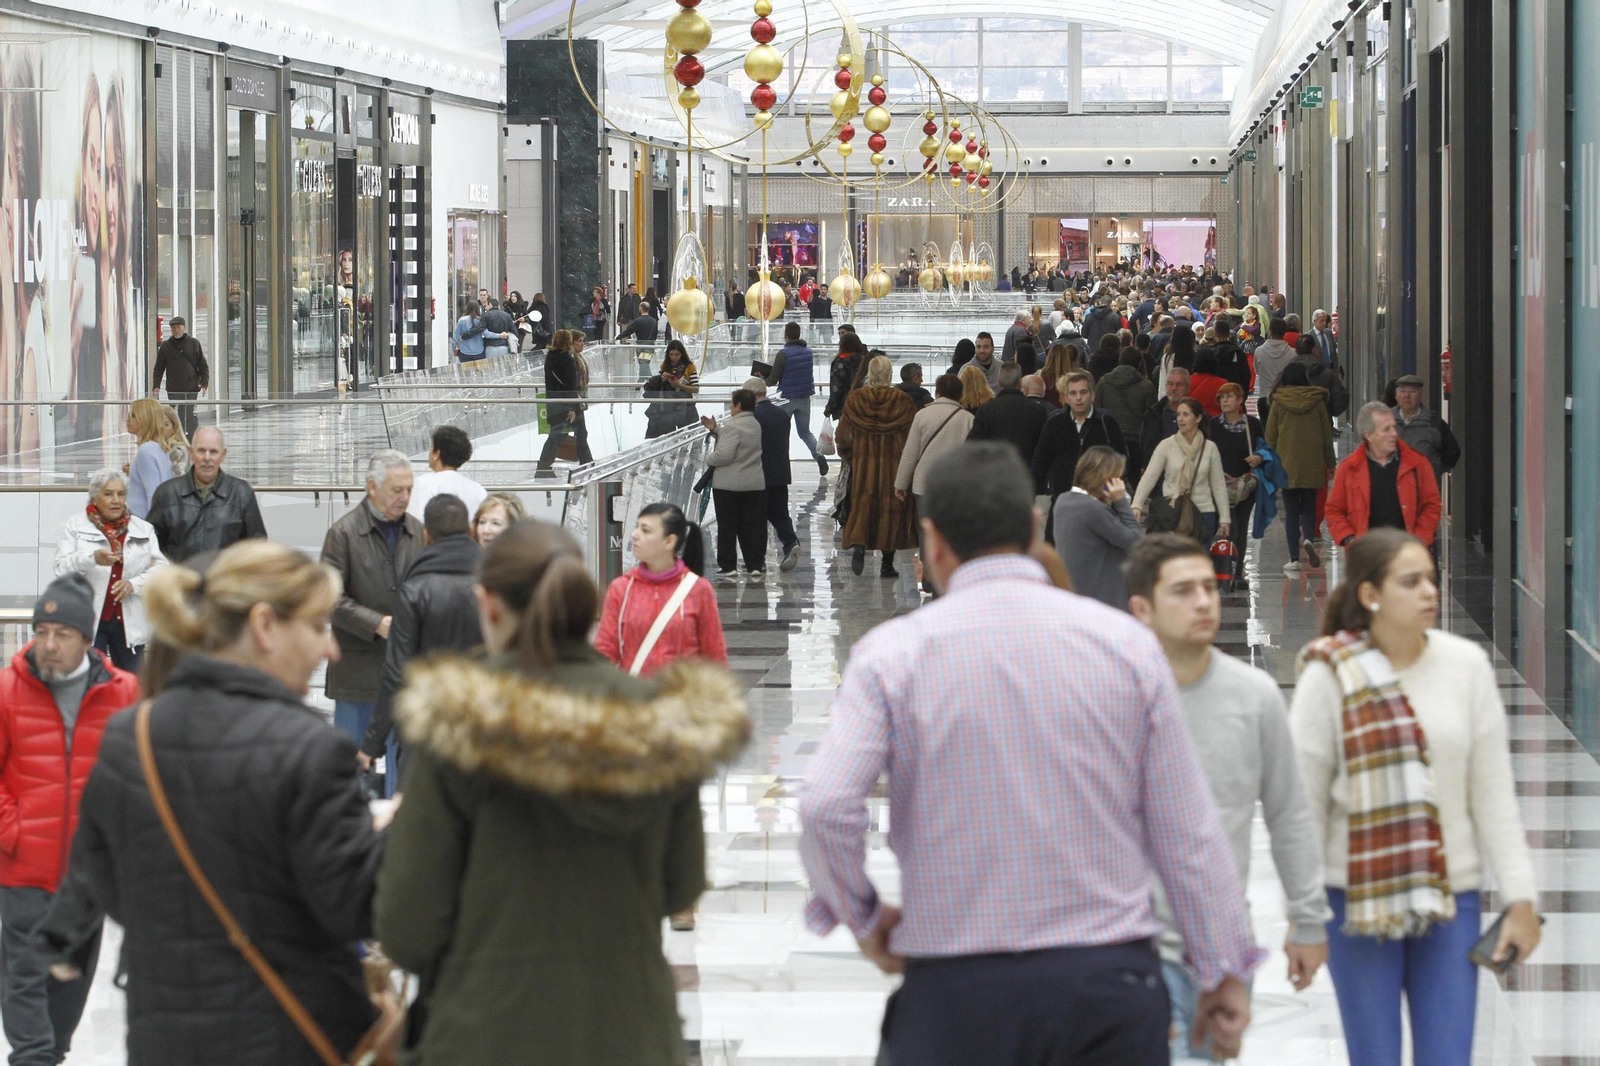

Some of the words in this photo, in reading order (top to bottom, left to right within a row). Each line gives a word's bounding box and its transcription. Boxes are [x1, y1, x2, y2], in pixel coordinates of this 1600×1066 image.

[303, 159, 326, 194] GUESS
[361, 164, 382, 198] GUESS
[887, 197, 937, 207] ZARA
[14, 198, 19, 283] I
[23, 198, 69, 284] LOVE
[1106, 231, 1141, 239] ZARA
